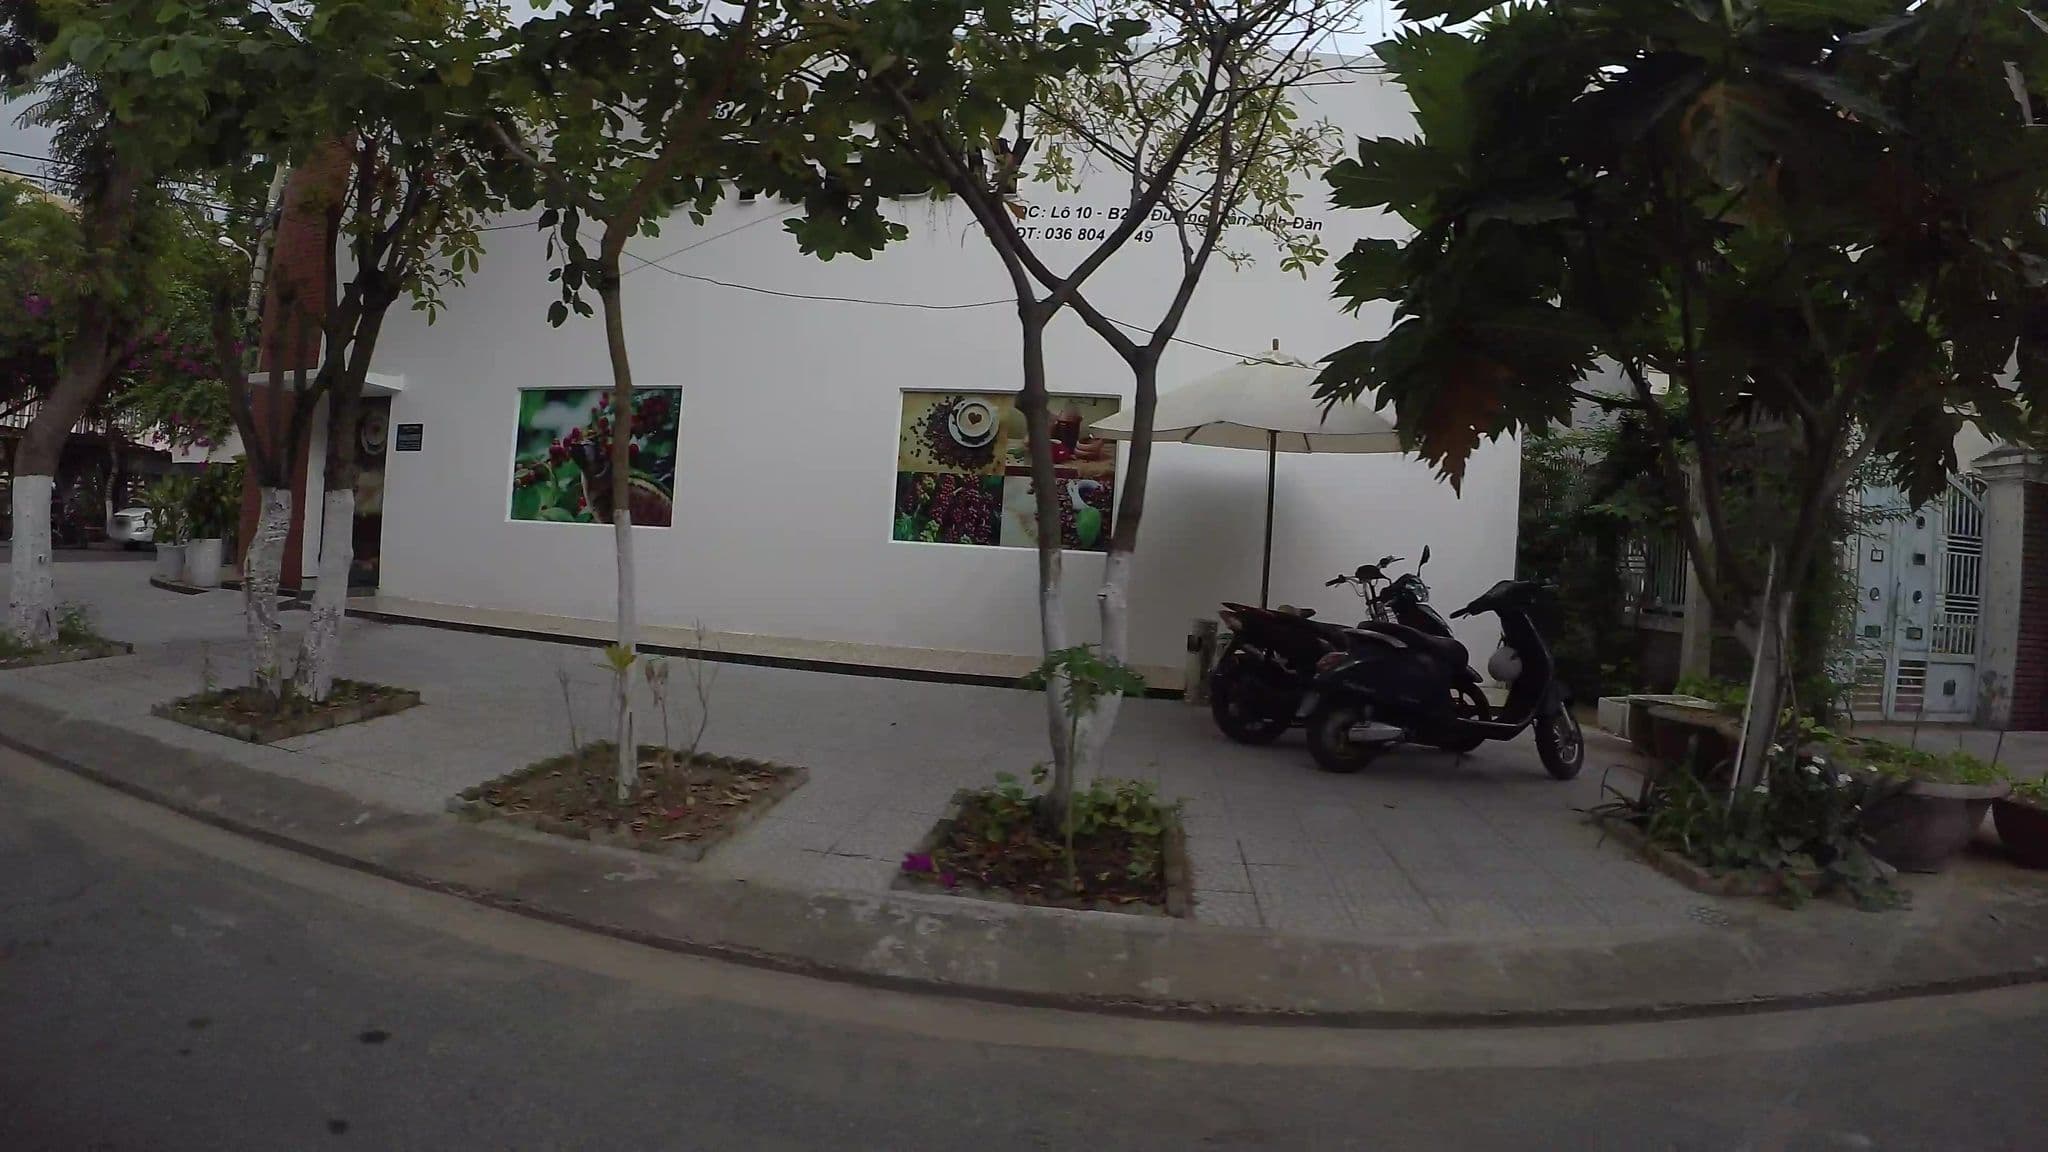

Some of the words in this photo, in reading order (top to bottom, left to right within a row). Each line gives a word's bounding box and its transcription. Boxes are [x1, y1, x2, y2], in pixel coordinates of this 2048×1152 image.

[1050, 206, 1071, 218] Lô
[1076, 206, 1092, 219] 10
[1291, 217, 1323, 231] Đàn
[1045, 227, 1073, 240] 036
[1077, 228, 1105, 241] 804
